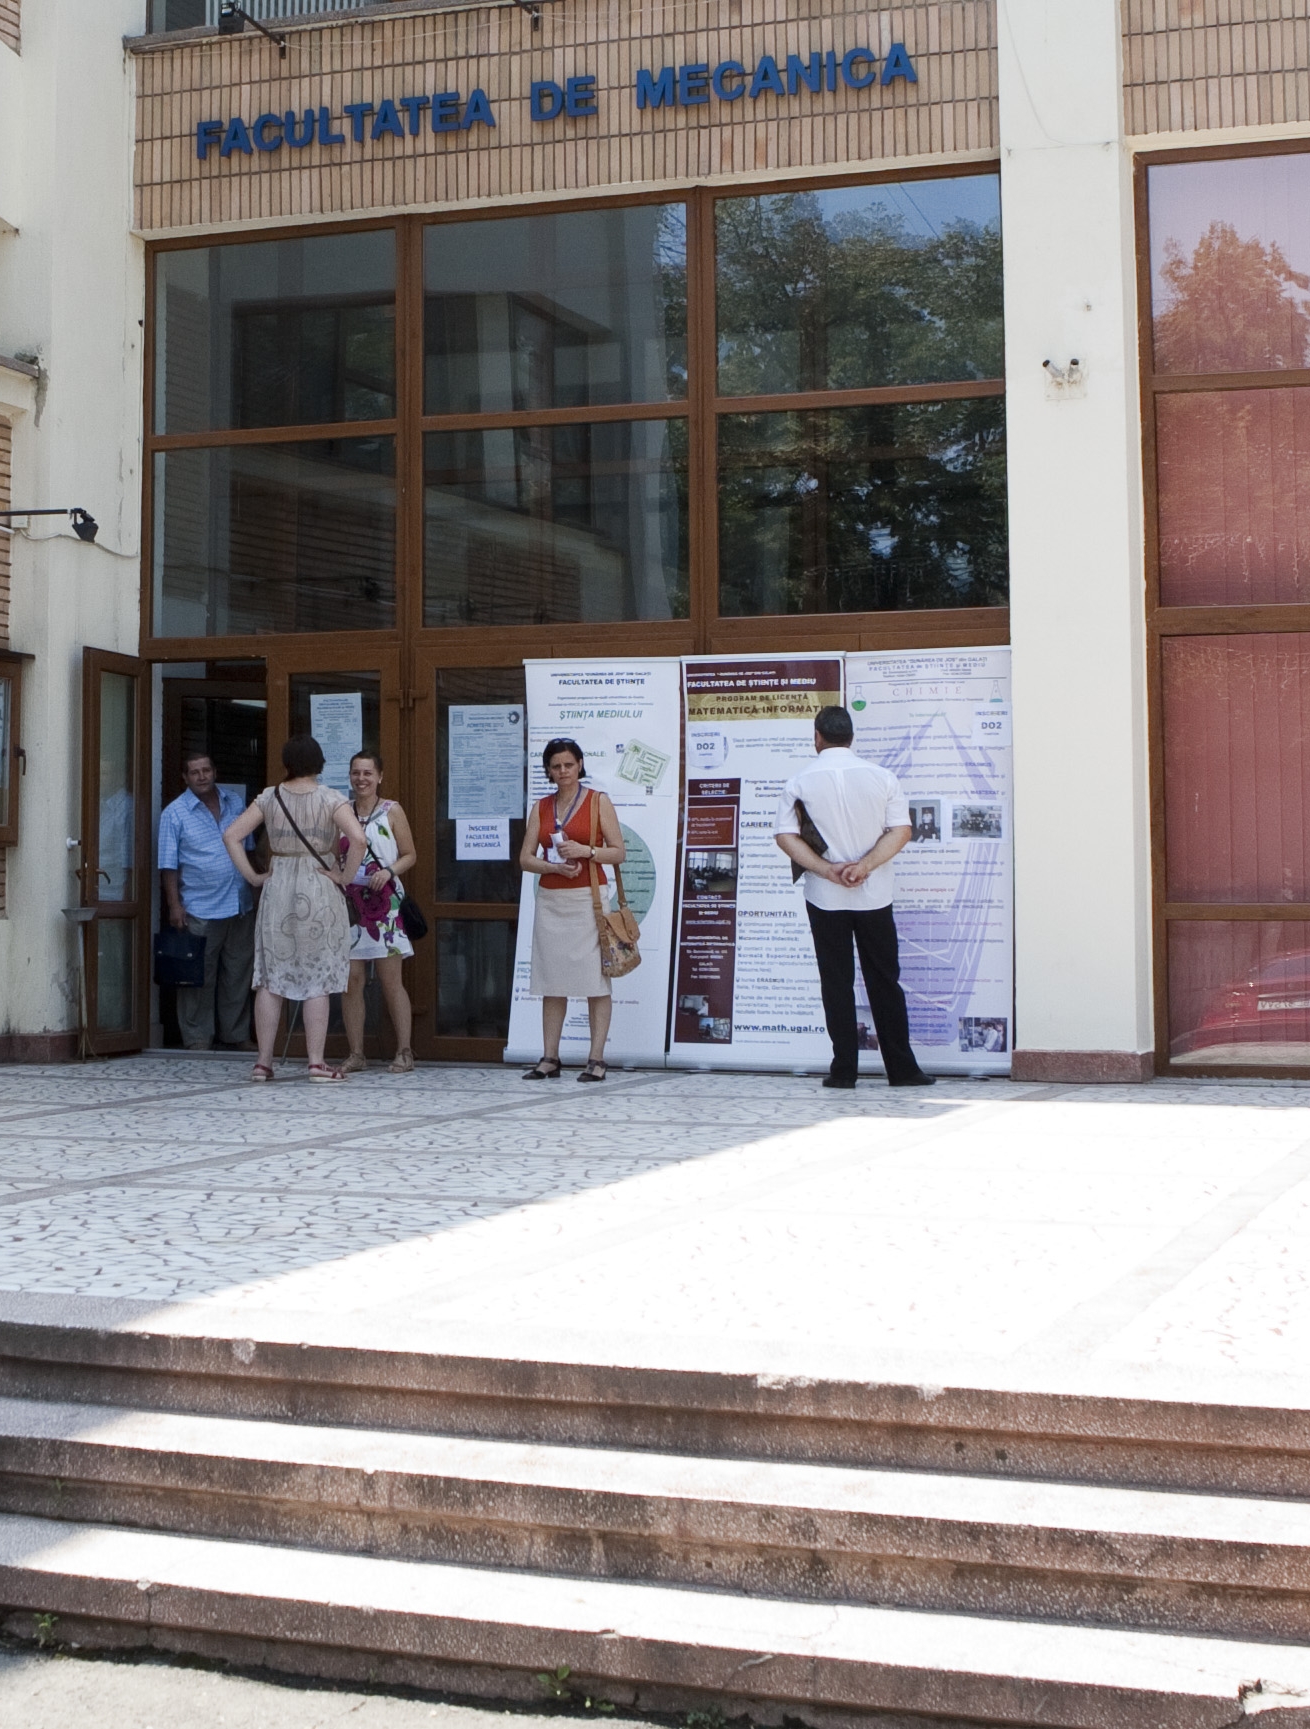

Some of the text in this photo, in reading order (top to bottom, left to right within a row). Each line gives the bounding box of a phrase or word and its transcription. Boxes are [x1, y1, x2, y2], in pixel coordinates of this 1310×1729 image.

[196, 42, 918, 160] FACULTATEA DE MECANICA
[686, 680, 734, 688] FACULTATEA
[736, 679, 746, 687] DE
[716, 694, 757, 702] PROGRAM
[597, 710, 643, 718] MEDIULUI
[734, 1024, 825, 1034] www.math.ugal.ro
